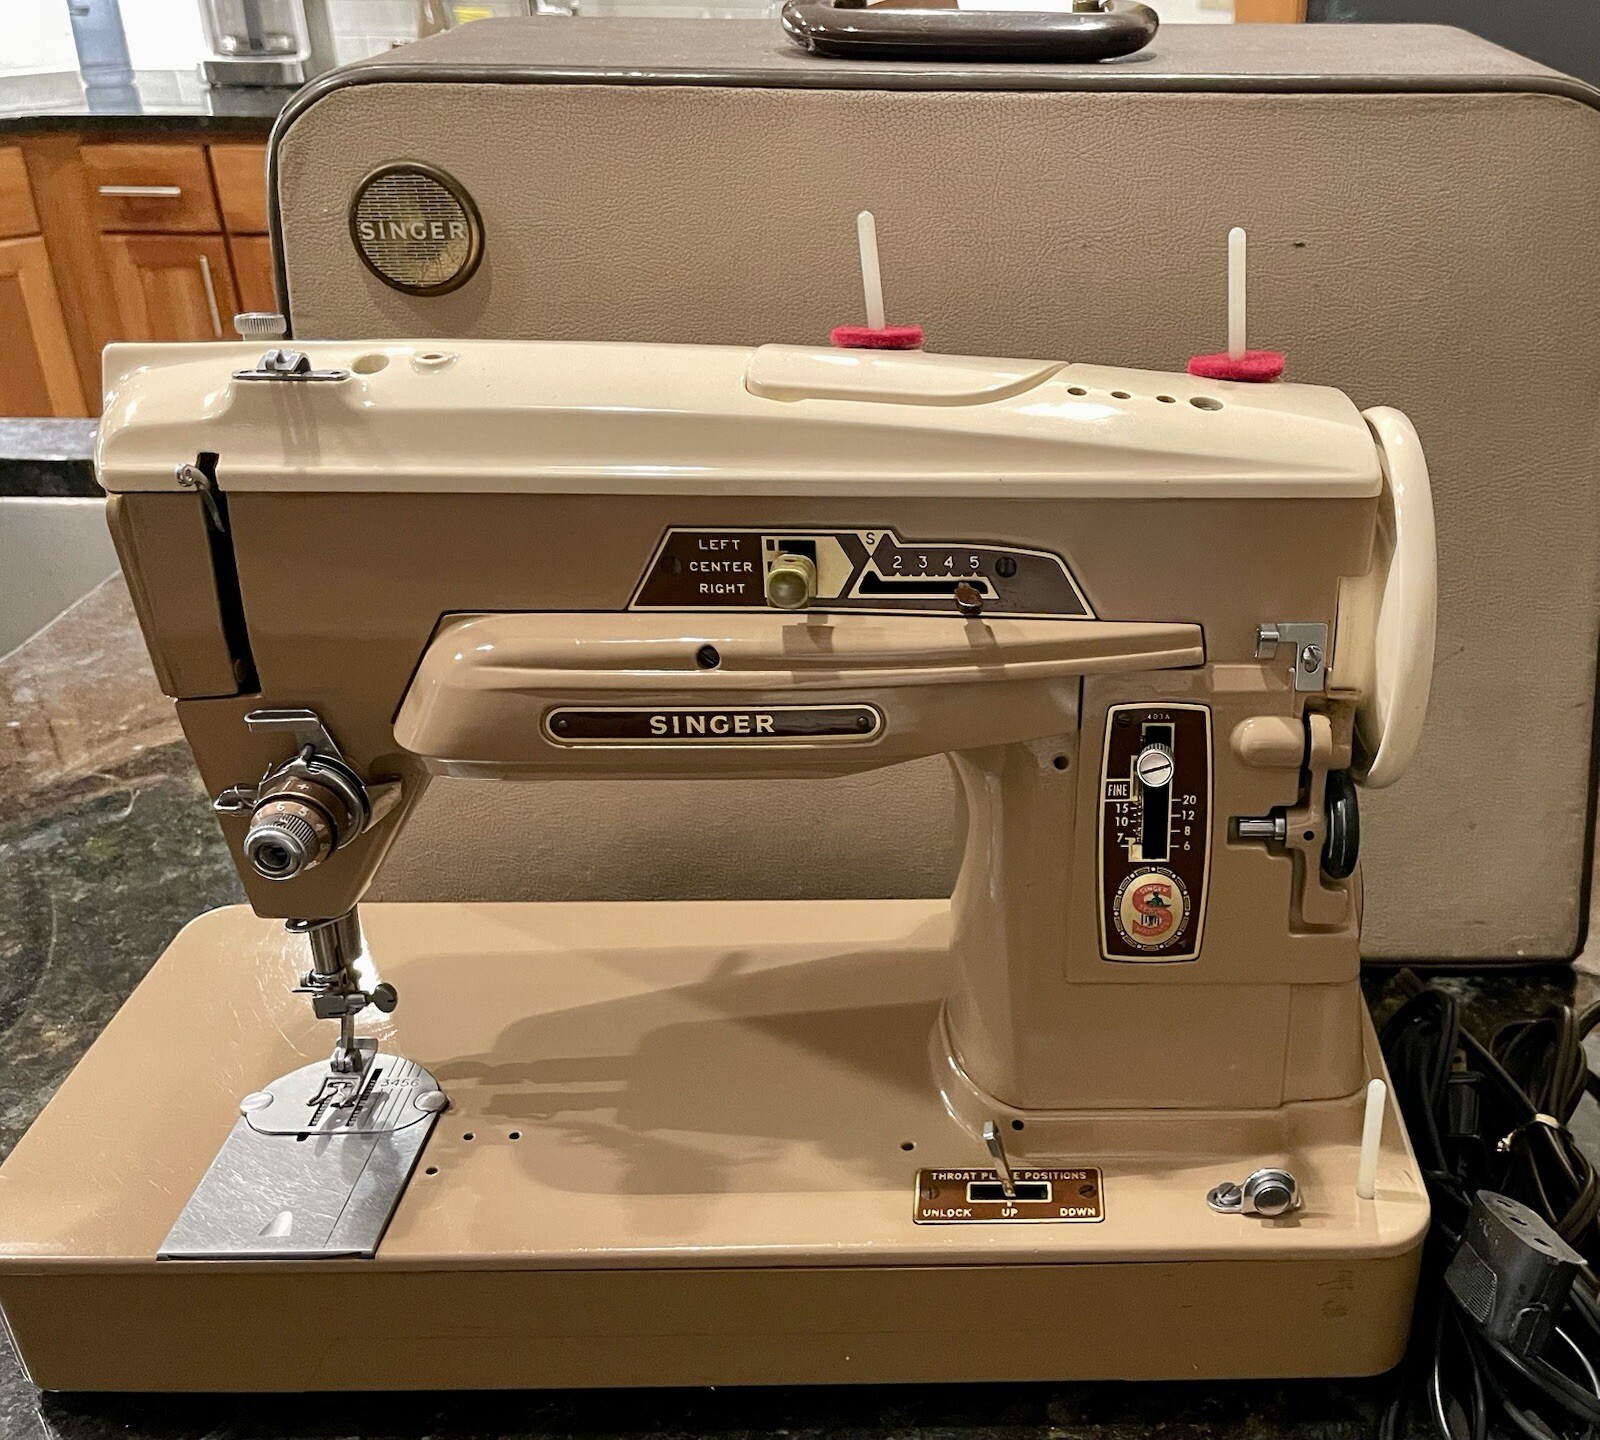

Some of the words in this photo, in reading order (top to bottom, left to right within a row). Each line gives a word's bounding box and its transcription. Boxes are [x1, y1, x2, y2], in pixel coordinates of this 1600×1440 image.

[360, 221, 466, 240] SINGER
[865, 532, 876, 545] S
[698, 539, 741, 550] LEFT
[689, 561, 753, 572] CENTER
[892, 555, 903, 569] 2
[918, 555, 929, 569] 3
[943, 555, 954, 569] 4
[968, 555, 980, 569] 5
[699, 583, 746, 594] RIGHT
[650, 714, 775, 734] SINGER
[1107, 783, 1128, 797] FINE
[1182, 794, 1197, 805] 20
[1115, 803, 1129, 815] 15
[1182, 810, 1195, 821] 12
[1115, 816, 1129, 827] 10
[1184, 825, 1191, 836] 8
[1116, 832, 1124, 843] 7
[1183, 841, 1191, 851] 6
[932, 1172, 977, 1181] THROAT
[981, 1171, 1021, 1180] PLE
[1024, 1171, 1087, 1180] POSITIONS
[922, 1208, 972, 1218] UNLOCK
[1001, 1208, 1019, 1218] UP
[1059, 1207, 1096, 1217] DOWN
